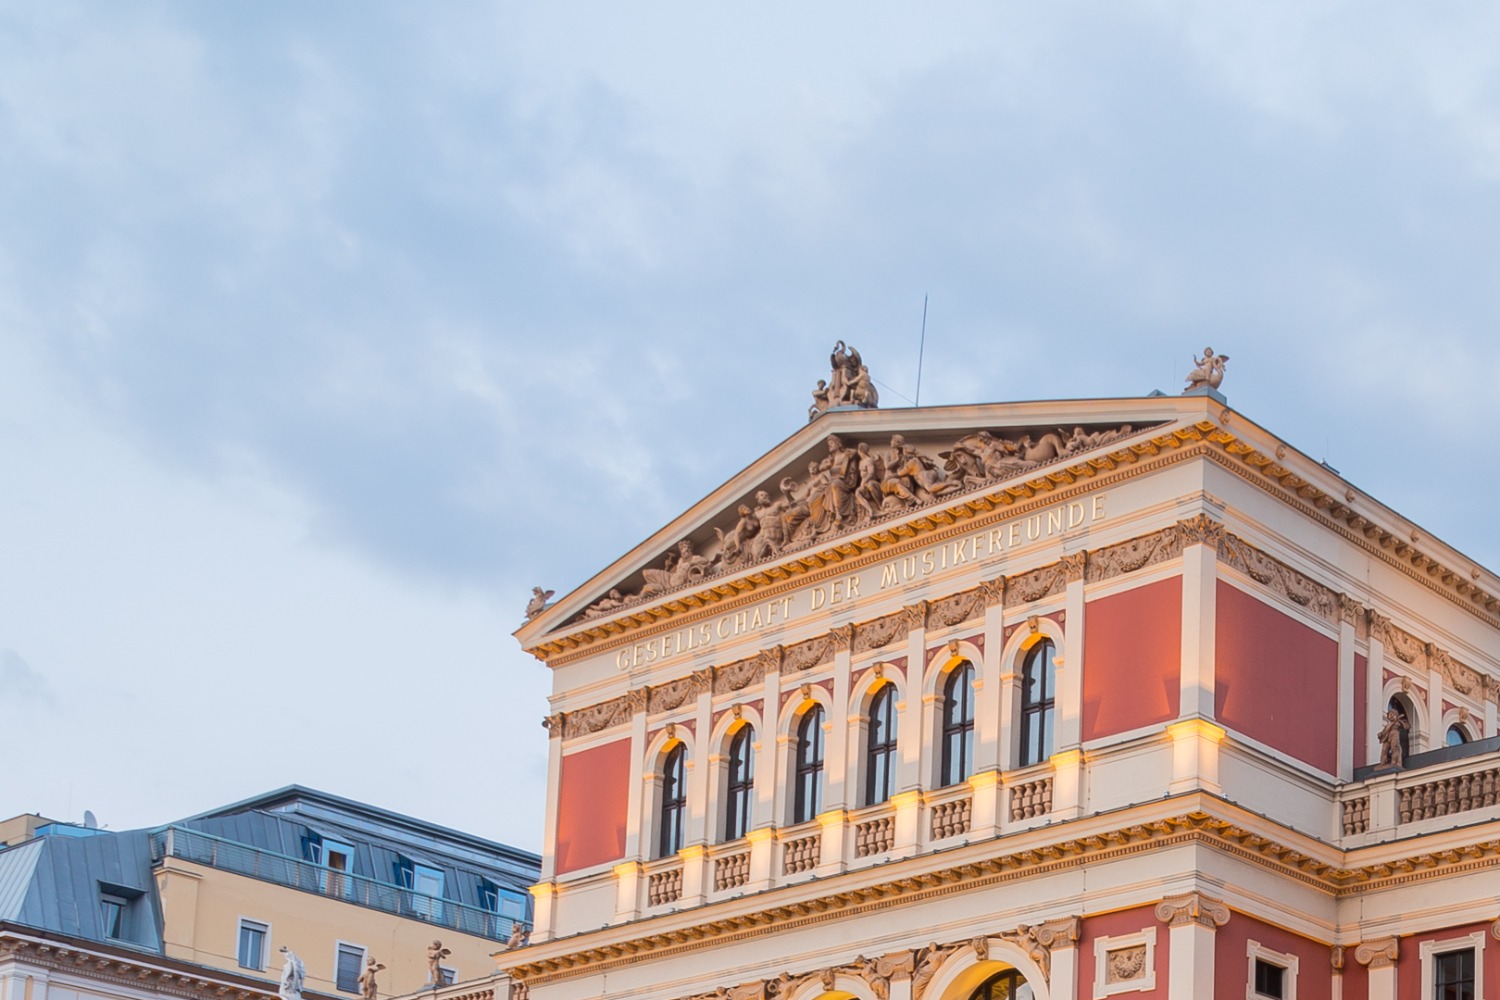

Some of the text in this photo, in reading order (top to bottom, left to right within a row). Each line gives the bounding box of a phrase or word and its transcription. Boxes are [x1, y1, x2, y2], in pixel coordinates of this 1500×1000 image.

[615, 492, 1109, 672] GESELLSCHAFT DER MUSIKFREUNDE
